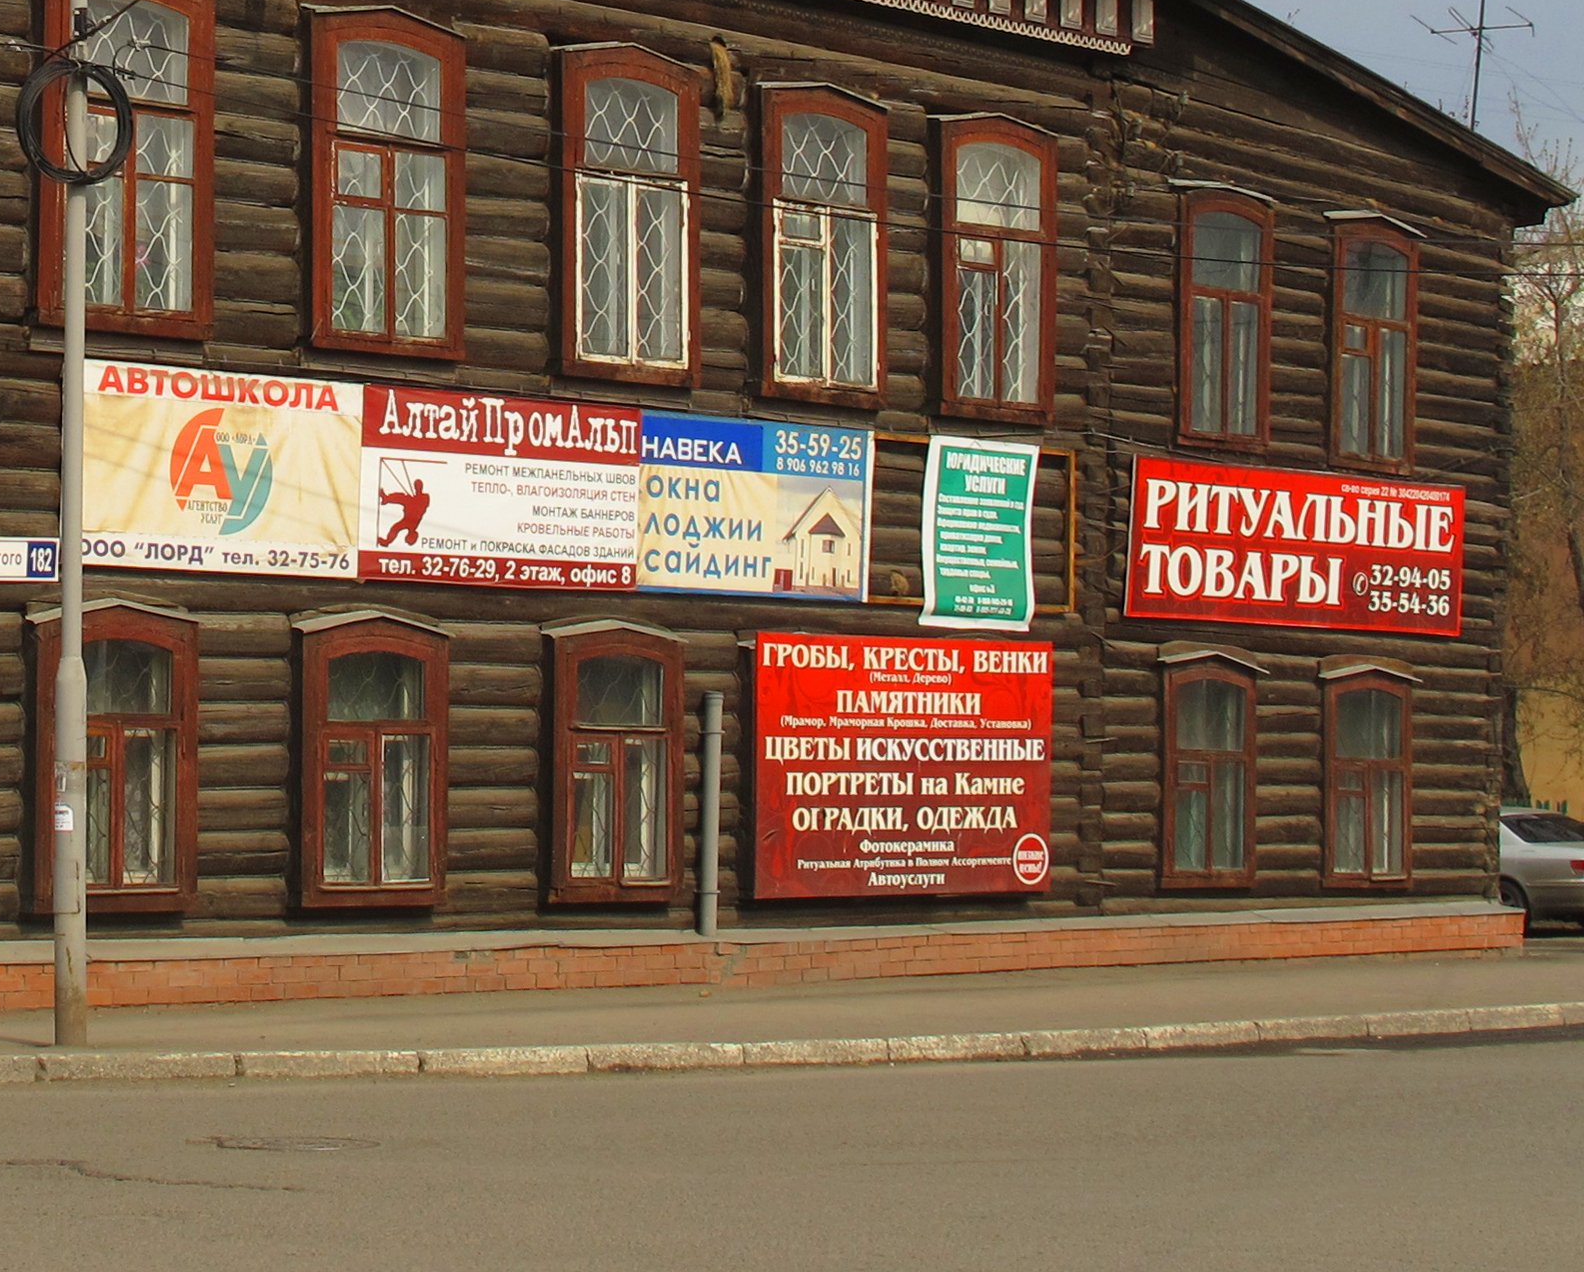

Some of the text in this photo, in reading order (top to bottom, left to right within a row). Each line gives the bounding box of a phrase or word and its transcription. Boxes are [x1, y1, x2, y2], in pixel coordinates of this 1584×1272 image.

[98, 365, 339, 411] АВТОШКОЛА
[642, 435, 743, 465] НАВЕКА
[775, 430, 862, 460] 35-59-25
[465, 463, 636, 485] РЕМОНТ МЕЖПАНЕЛЬНЫХ ШВОВ
[776, 457, 860, 477] 8 906 962 98 16
[946, 451, 1027, 477] ЮРИДИЧЕСКИЕ
[471, 481, 636, 502] ТЕПЛО-, ВЛАГОИЗОЛЯЦИЯ СТЕН
[646, 475, 720, 502] окна
[964, 474, 1007, 495] УСЛУГИ
[188, 500, 228, 512] АГЕНТСТВО
[532, 505, 635, 521] МОНТАЖ БАННЕРОВ
[1143, 478, 1455, 552] РИТУАЛЬНЫЕ
[517, 522, 635, 539] КРОВЕЛЬНЫЕ РАБОТЫ
[644, 512, 762, 542] лоджии
[30, 547, 53, 573] 182
[222, 552, 260, 566] тел.
[267, 550, 350, 570] 32-75-76
[421, 537, 467, 550] РЕМОНТ
[480, 540, 535, 554] ПОКРАСКА
[538, 545, 590, 559] ФАСАДОВ
[593, 546, 635, 559] ЗДАНИЙ
[645, 542, 772, 578] сайдинг
[378, 556, 632, 587] тел. 32-76-29, 2 этаж, офис 8
[1140, 543, 1344, 606] ТОВАРЫ
[1370, 564, 1451, 590] 32-94-05
[1368, 590, 1450, 616] 35-54-36
[763, 642, 1048, 674] ГРОБЫ, КРЕСТЫ, ВЕНКИ
[912, 672, 952, 685] Дерево)
[836, 689, 982, 715] ПАМЯТНИКИ
[829, 715, 885, 730] Мраморная
[979, 718, 1032, 731] Установка)
[764, 736, 1046, 765] ЦВЕТЫ ИСКУССТВЕННЫЕ
[786, 772, 1025, 796] ПОРТРЕТЫ на Камне
[792, 806, 1018, 836] ОГРАДКИ, ОДЕЖДА
[859, 839, 955, 857] Фотокерамика
[797, 856, 1012, 872] Ритуальная Атрибутика в Полном Ассортименте
[867, 871, 945, 888] Автоуслуги
